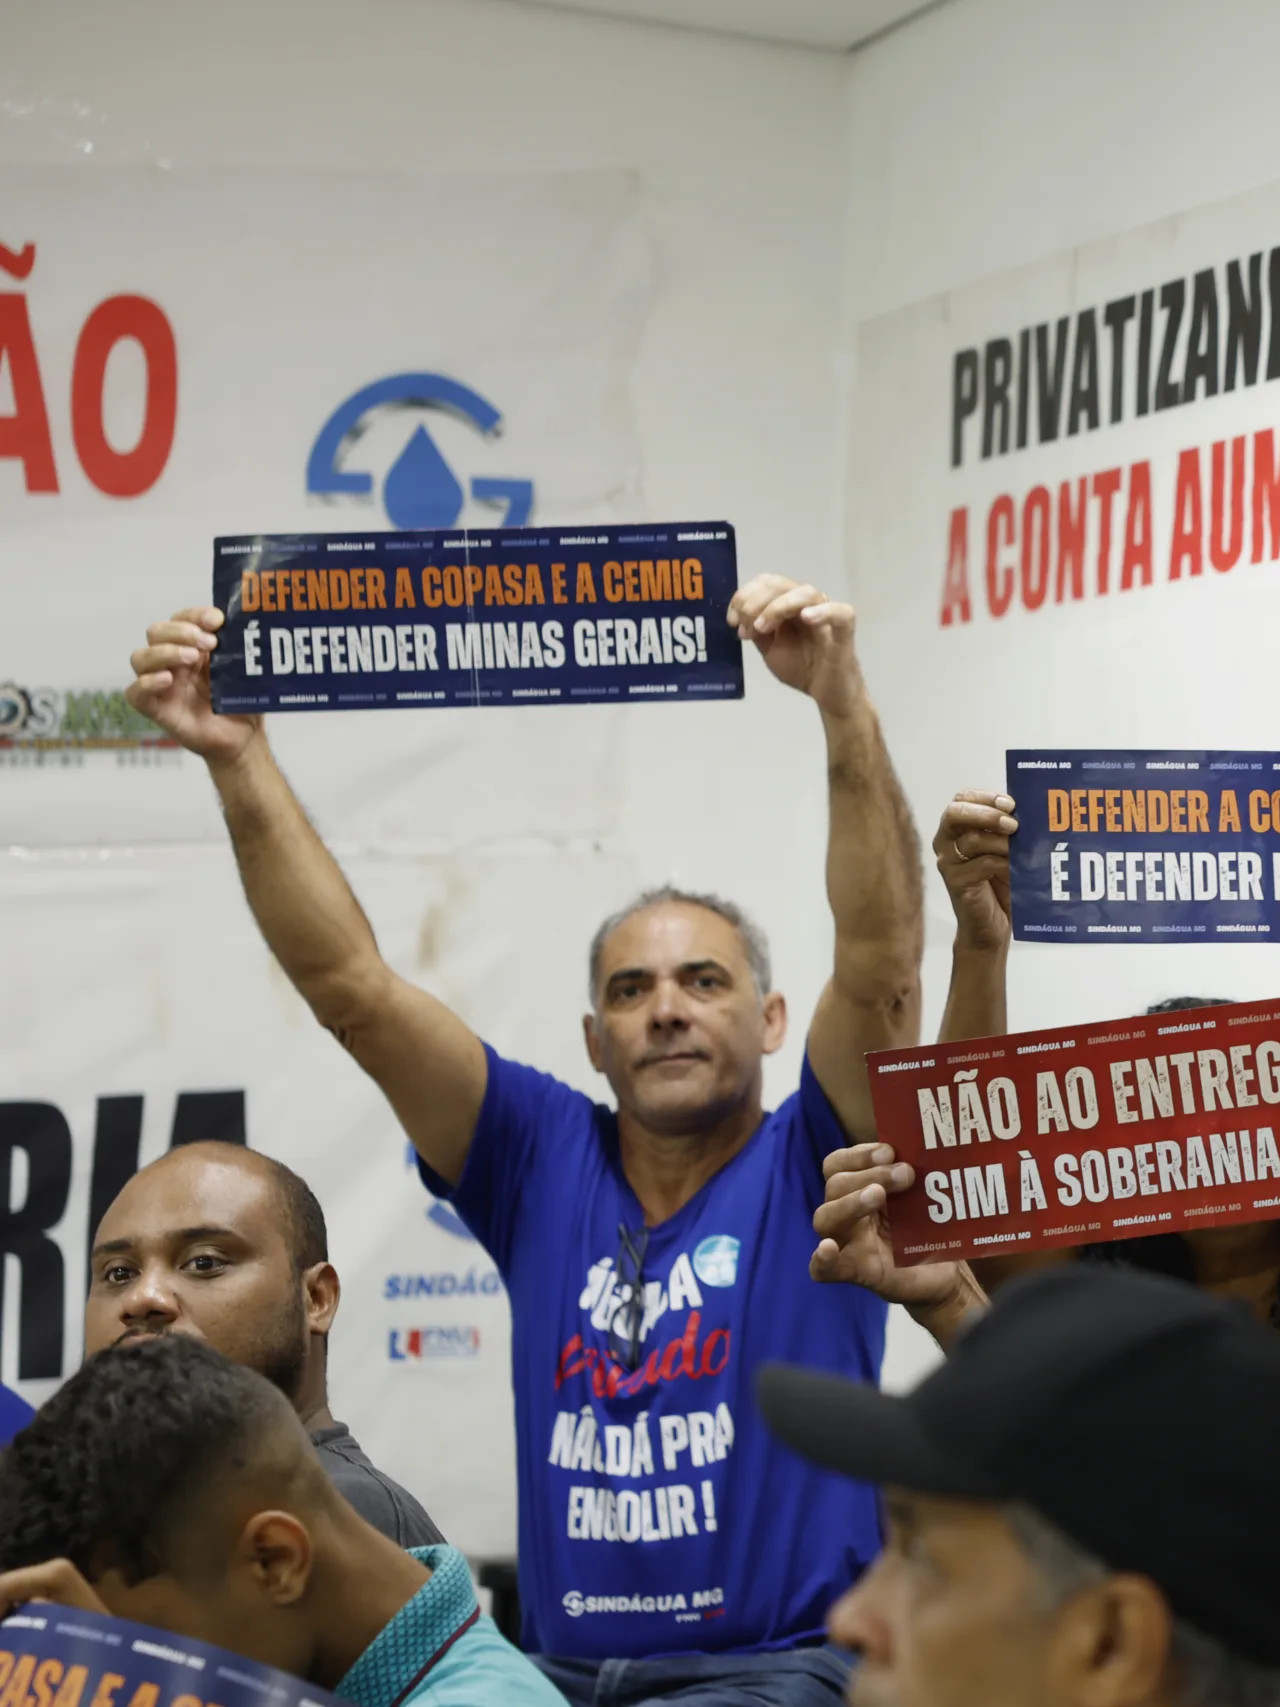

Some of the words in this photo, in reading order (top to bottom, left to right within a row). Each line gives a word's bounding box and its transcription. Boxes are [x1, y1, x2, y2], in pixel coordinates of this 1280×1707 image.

[940, 506, 971, 628] A
[986, 460, 1154, 617] CONTA
[241, 568, 387, 613] DEFENDER
[395, 567, 416, 608] A
[421, 563, 545, 608] COPASA
[551, 563, 568, 604] E
[576, 562, 597, 604] A
[602, 557, 704, 603] CEMIG
[243, 620, 263, 676] É
[270, 623, 439, 675] DEFENDER
[445, 620, 566, 670] MINAS
[573, 615, 708, 668] GERAIS!
[1017, 761, 1057, 769] SINDÁGUA
[1047, 789, 1210, 833] DEFENDER
[1218, 789, 1242, 832] A
[1051, 842, 1070, 901] É
[1080, 851, 1264, 901] DEFENDER
[1087, 924, 1128, 932] SINDÁGUA
[878, 1060, 921, 1073] SINDÁGUA
[922, 1059, 936, 1067] MG
[1017, 1042, 1061, 1055] SINDÁGUA
[1062, 1040, 1076, 1049] MG
[1158, 1023, 1201, 1036] SINDÁGUA
[1202, 1021, 1216, 1030] MG
[917, 1068, 1021, 1150] NÃO
[1036, 1066, 1099, 1135] AO
[924, 1163, 1009, 1223] SIM
[1018, 1150, 1048, 1212] À
[973, 1233, 1016, 1245] SINDÁGUA
[1017, 1231, 1031, 1240] MG
[1113, 1214, 1157, 1227] SINDÁGUA
[1158, 1213, 1172, 1221] MG
[604, 1411, 655, 1478] DÁ
[659, 1402, 735, 1471] PRA
[585, 1592, 687, 1613] SINDÁGUA
[692, 1587, 724, 1608] MG
